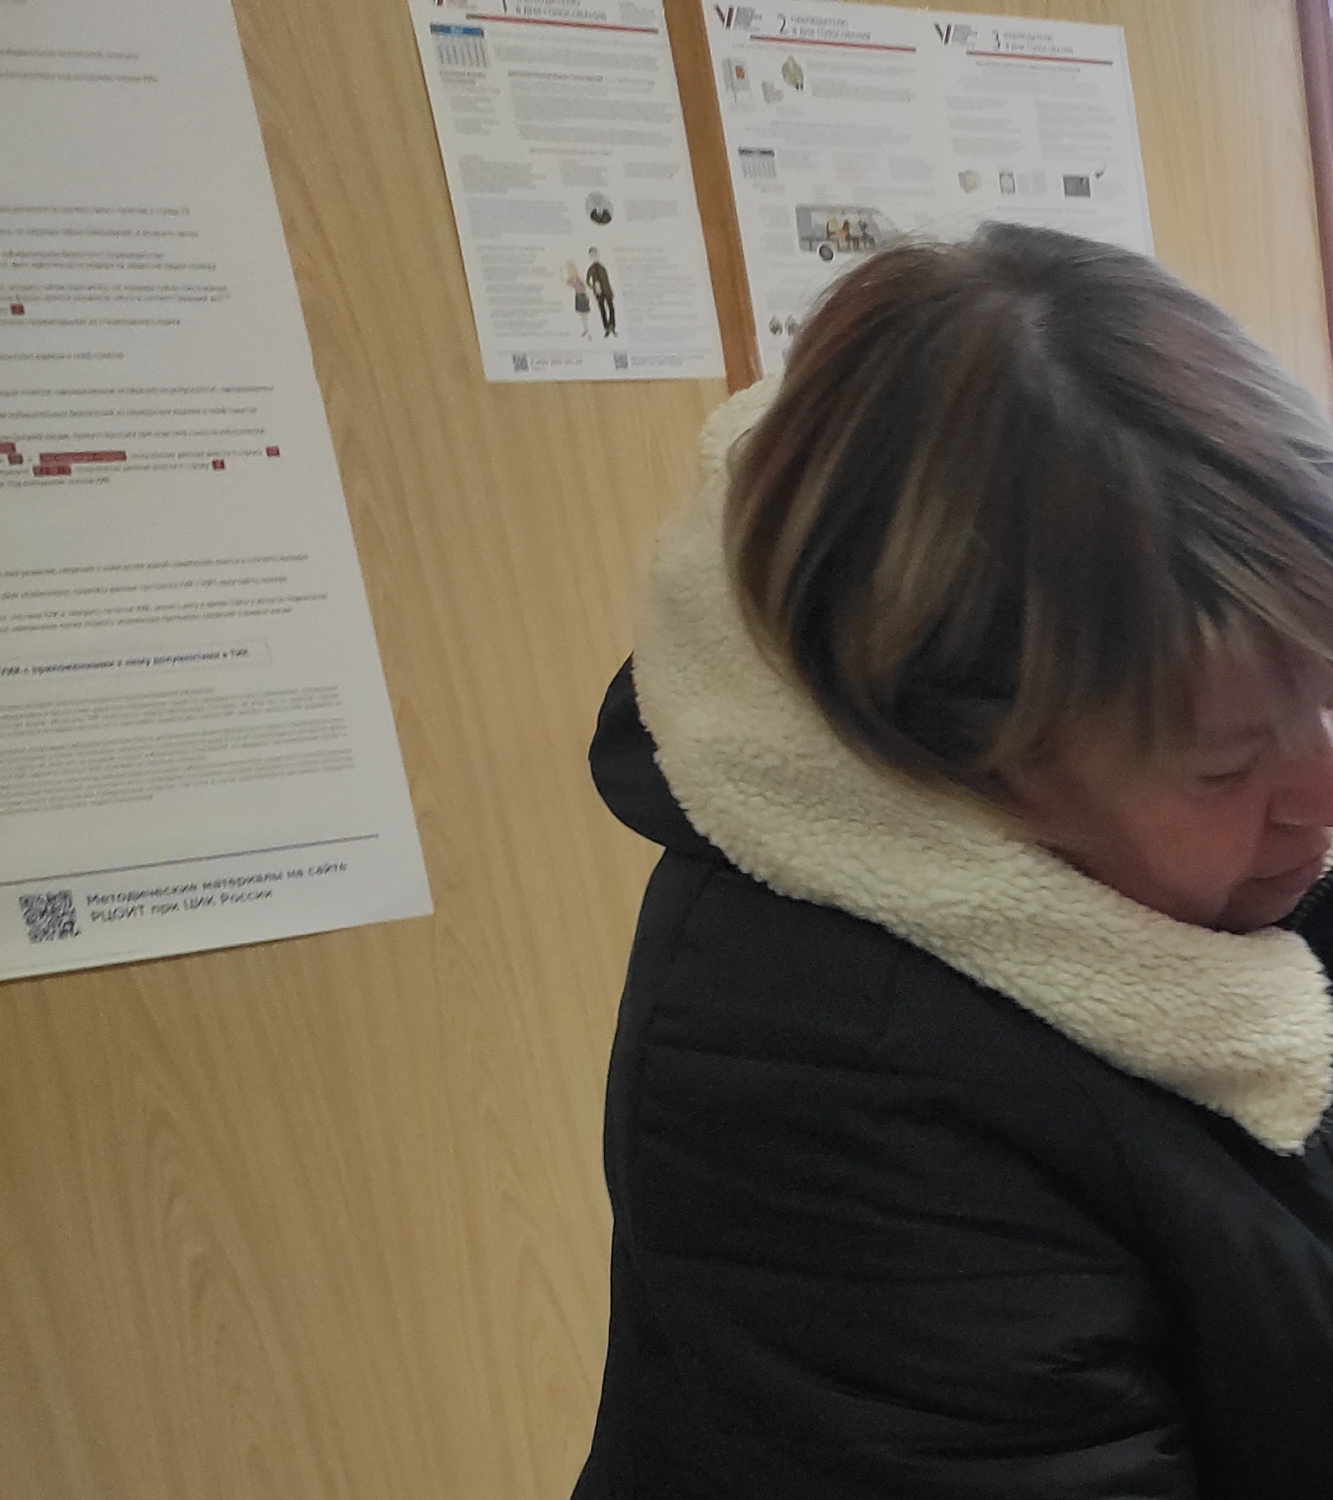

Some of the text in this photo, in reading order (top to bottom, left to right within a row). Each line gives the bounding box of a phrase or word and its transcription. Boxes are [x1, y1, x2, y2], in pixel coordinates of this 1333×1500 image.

[87, 862, 349, 905] Методические материалы на сайте
[220, 889, 273, 906] России
